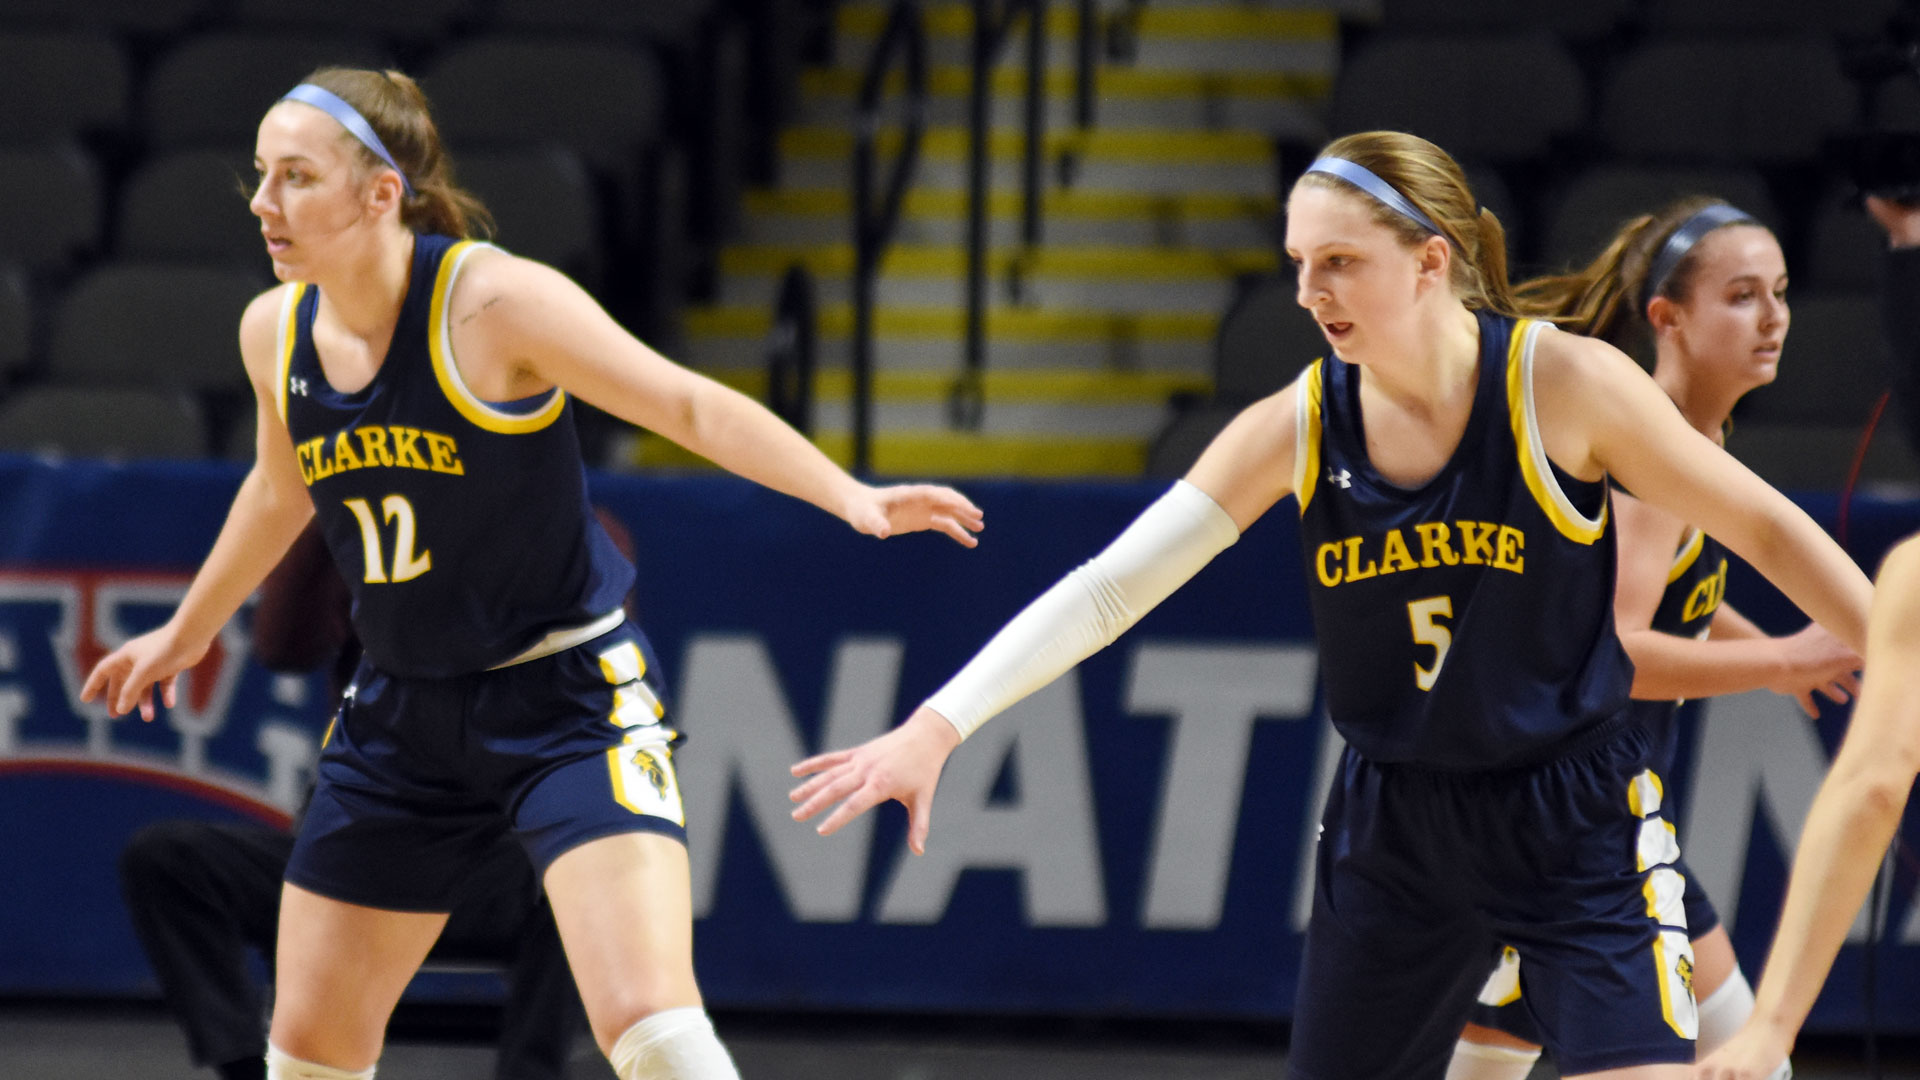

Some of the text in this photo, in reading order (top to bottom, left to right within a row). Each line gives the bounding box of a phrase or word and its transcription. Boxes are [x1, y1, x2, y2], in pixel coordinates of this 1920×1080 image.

[296, 425, 465, 486] CLARKE
[342, 494, 432, 583] 12
[1316, 520, 1525, 588] CLARKE
[1682, 558, 1728, 623] CL
[1407, 595, 1453, 692] 5
